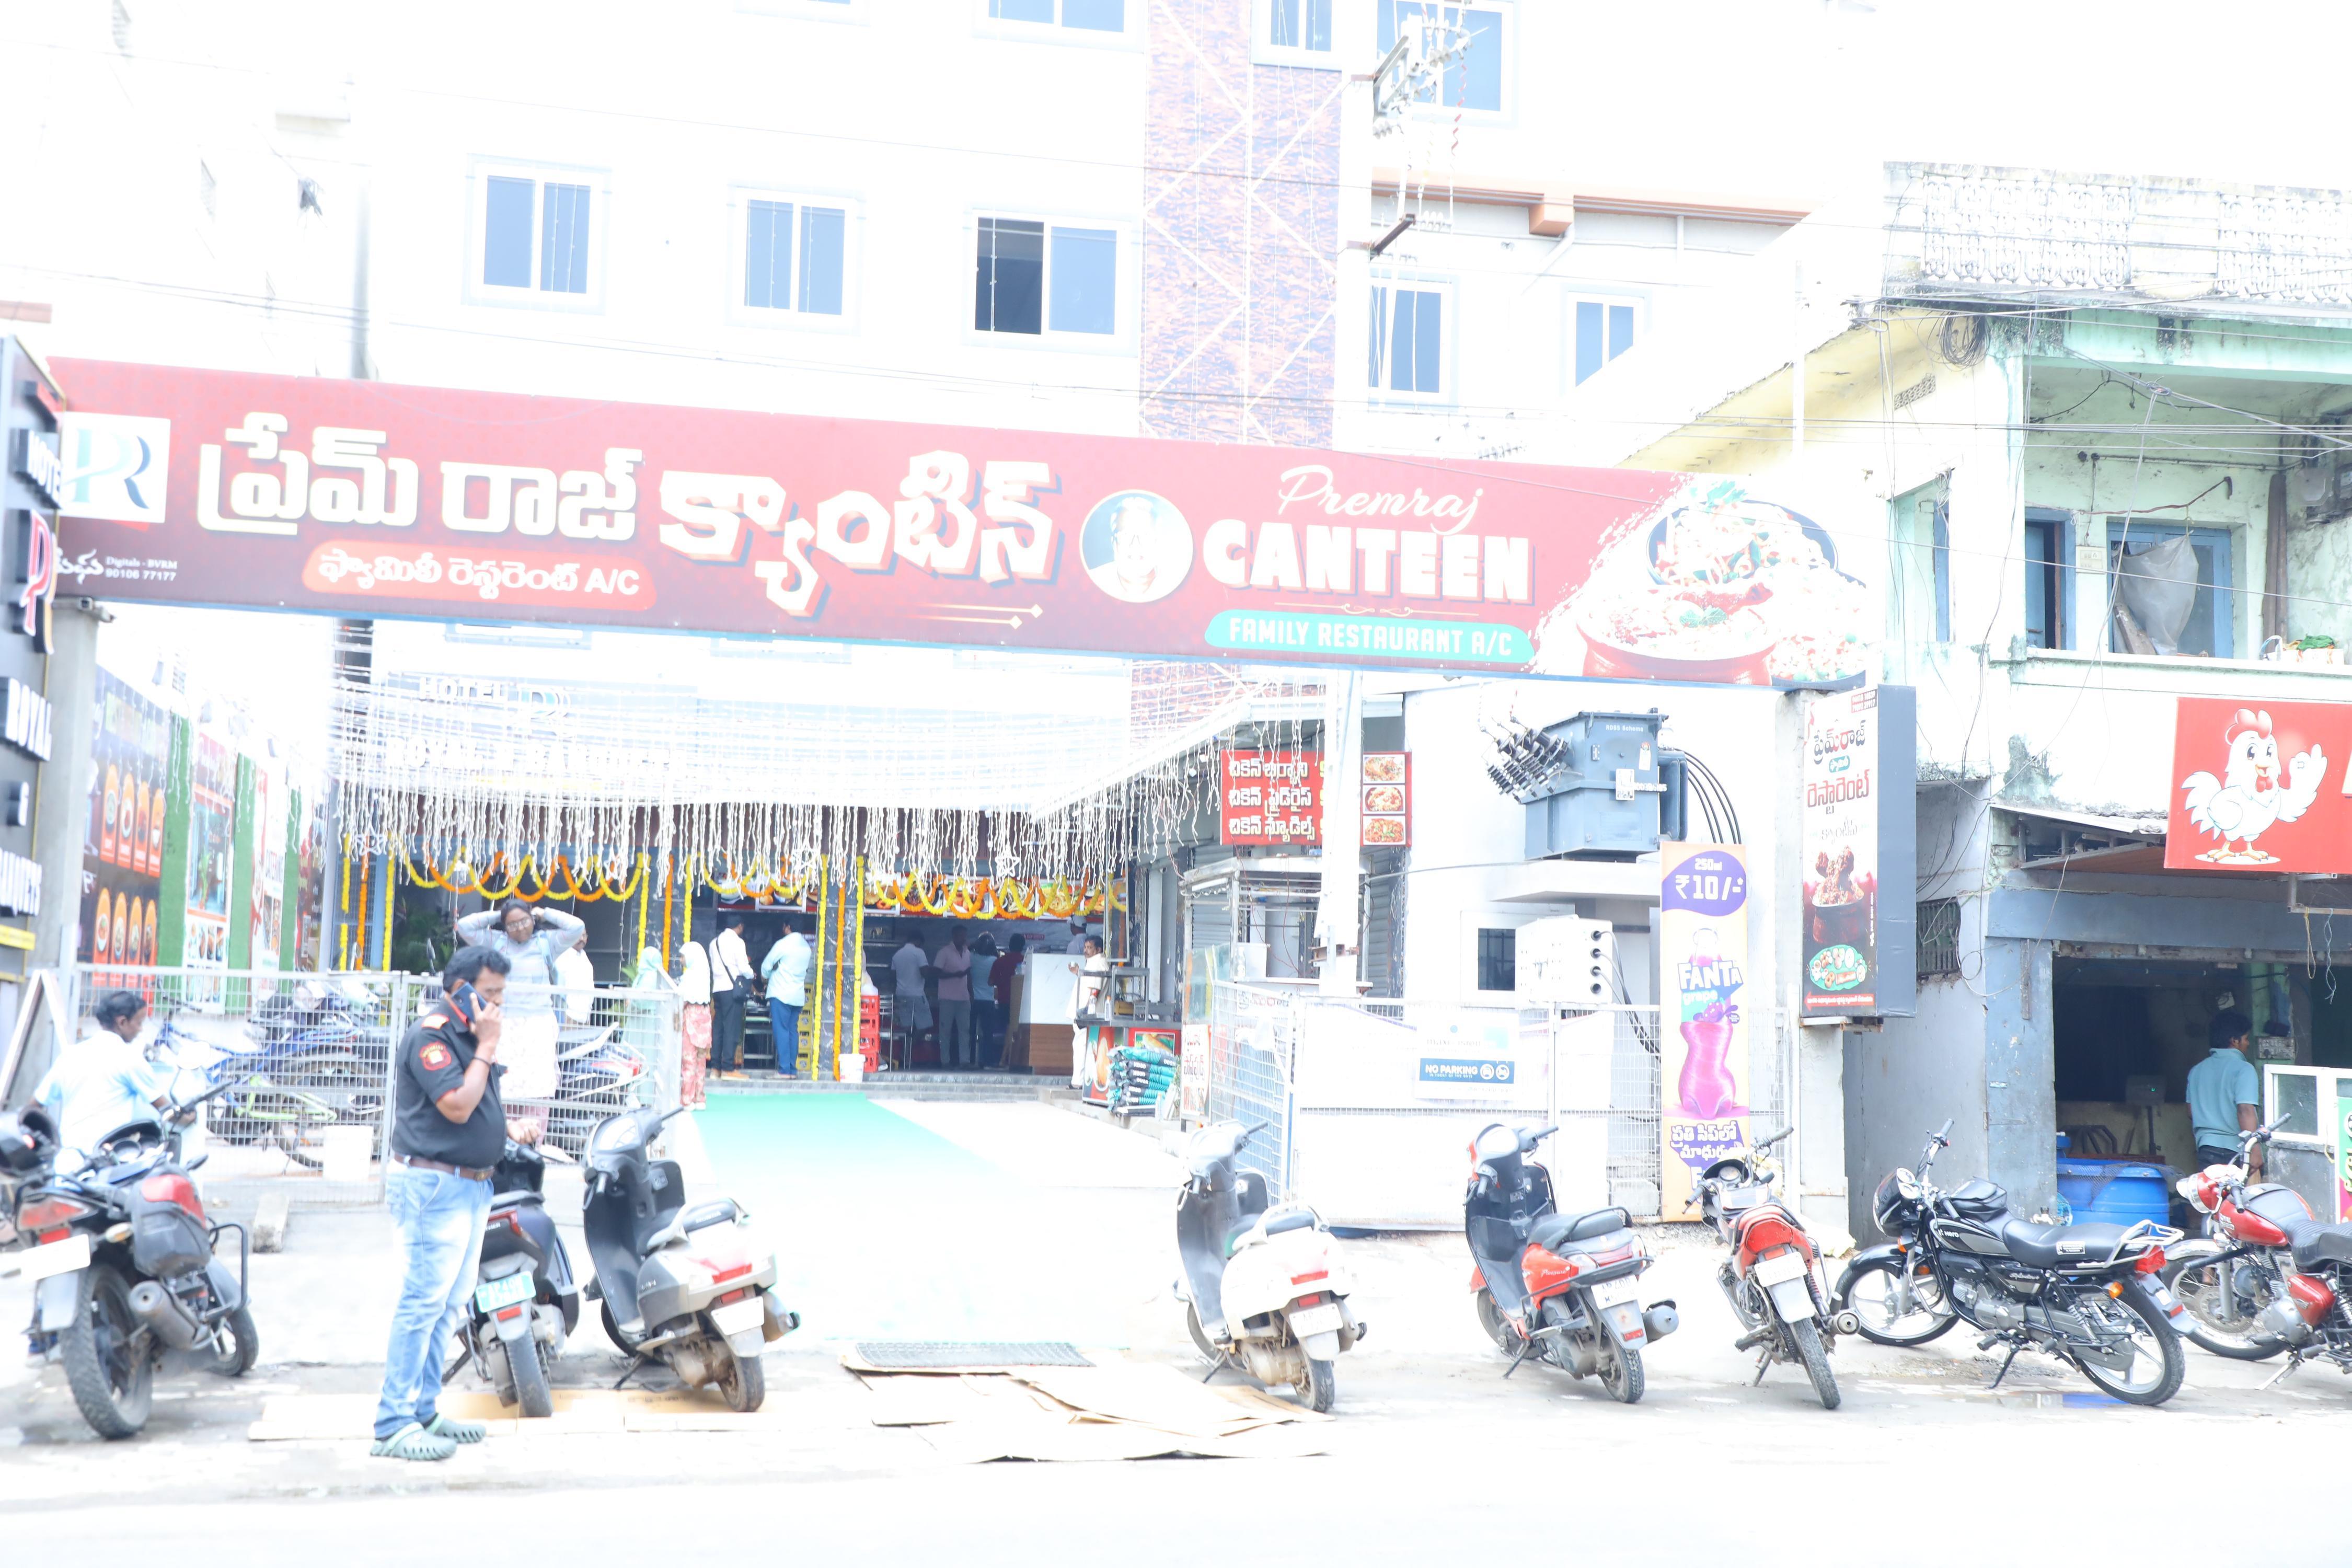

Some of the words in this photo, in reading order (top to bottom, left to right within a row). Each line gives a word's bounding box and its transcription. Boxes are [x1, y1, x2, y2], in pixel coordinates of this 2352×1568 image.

[198, 412, 419, 535] ప్రేమ్
[440, 447, 643, 540] రాజ్
[1278, 465, 1483, 535] Premraj
[106, 556, 141, 569] Digitals
[148, 559, 177, 570] BVRM
[1203, 519, 1532, 604] CANTEEN
[143, 570, 177, 582] 77177
[585, 567, 639, 594] A/C
[1229, 617, 1309, 647] FAMILY
[1318, 622, 1462, 653] RESTAURANT
[1471, 631, 1512, 656] A/C
[420, 677, 508, 703] HOTEL
[1694, 858, 1722, 871] 250ml
[1679, 961, 1743, 991] FANTA
[1682, 989, 1719, 1007] grape
[1425, 1064, 1438, 1074] NO
[1440, 1065, 1478, 1075] PARKING
[1671, 1124, 1694, 1148] ప్రతి
